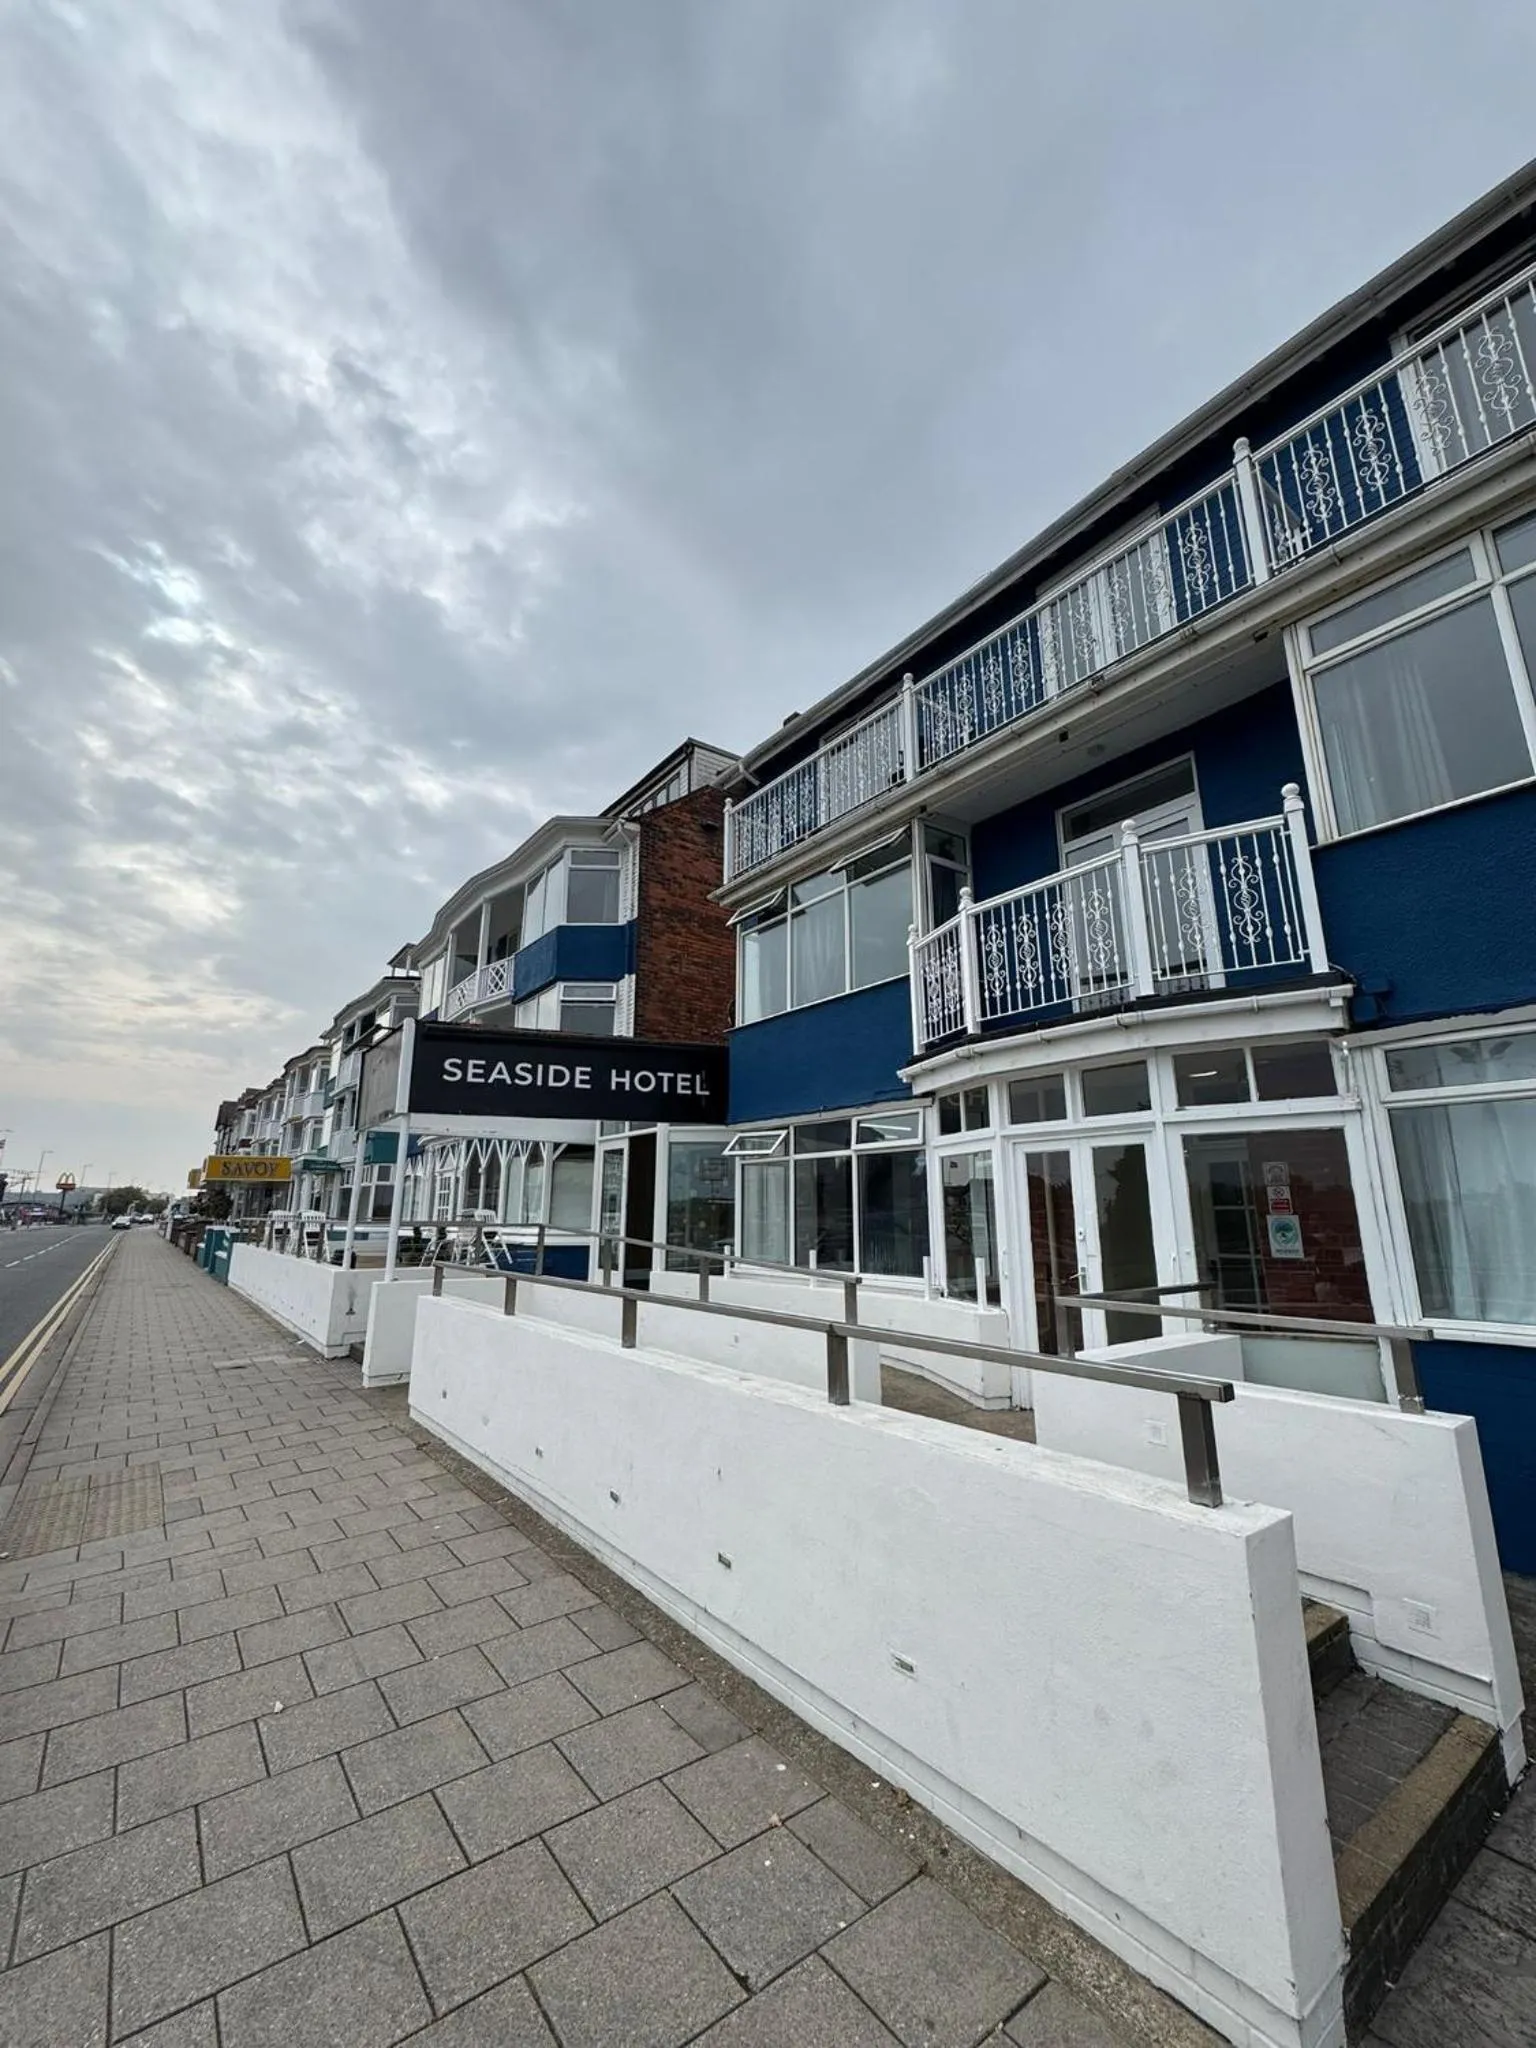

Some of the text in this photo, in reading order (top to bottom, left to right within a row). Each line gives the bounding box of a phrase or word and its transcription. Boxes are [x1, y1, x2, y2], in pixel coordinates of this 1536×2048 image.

[442, 1057, 711, 1096] SEASIDE HOTEL
[222, 1161, 277, 1177] SAVOY
